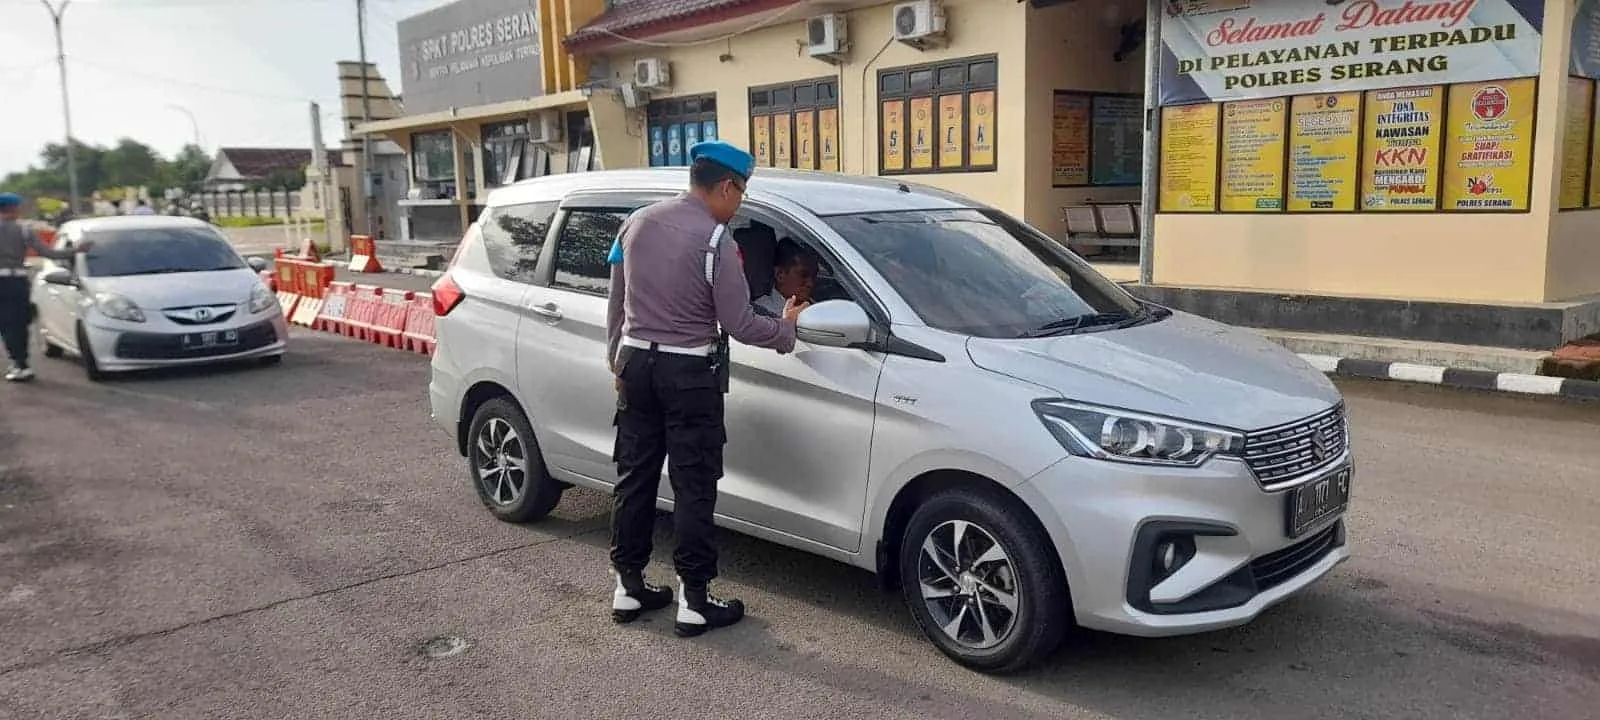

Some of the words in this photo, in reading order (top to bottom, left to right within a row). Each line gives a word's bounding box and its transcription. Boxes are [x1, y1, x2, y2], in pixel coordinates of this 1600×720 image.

[1206, 12, 1325, 47] Selamat
[1335, 0, 1477, 32] Datang
[422, 35, 448, 61] SPKT
[451, 21, 494, 54] POLRES
[1179, 58, 1201, 73] DI
[1210, 40, 1359, 71] PELAYANAN
[1370, 23, 1516, 53] TERPADU
[1224, 67, 1321, 90] POLRES
[1331, 55, 1448, 81] SERANG
[1392, 101, 1414, 112] ZONA
[1377, 111, 1430, 124] INTEGRITAS
[1376, 126, 1429, 138] KAWASAN
[1375, 148, 1427, 166] KKN
[1461, 151, 1513, 161] GRATIFIKASI
